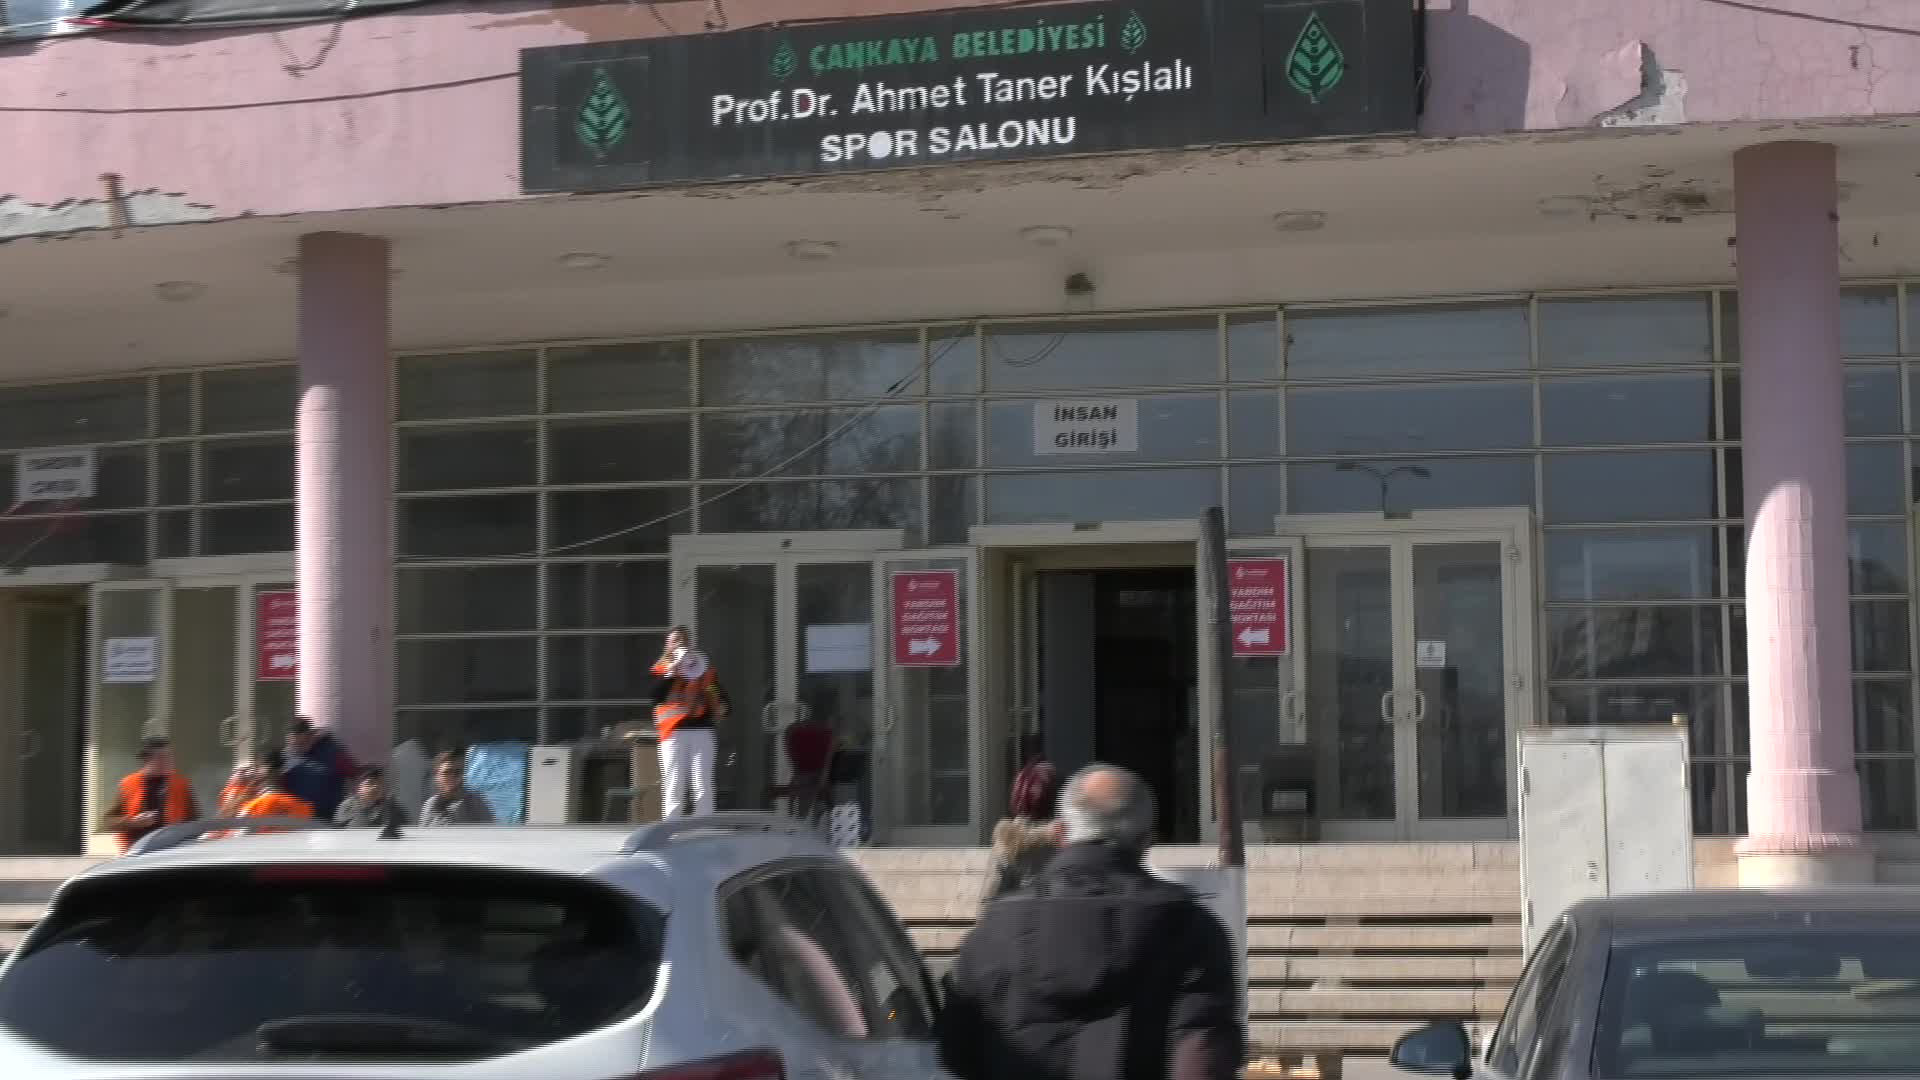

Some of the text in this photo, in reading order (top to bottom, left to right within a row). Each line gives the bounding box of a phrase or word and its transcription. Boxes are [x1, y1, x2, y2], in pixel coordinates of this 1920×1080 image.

[809, 15, 1105, 77] ÇANKAYA BELEDİYESİ
[711, 58, 1193, 127] Prof.Dr. Ahmet Taner Kışlalı
[820, 116, 1076, 162] SPOR SALONU
[1054, 404, 1118, 422] İNSAN
[1054, 427, 1117, 449] GİRİŞİ
[1231, 587, 1275, 598] YARDIM
[902, 599, 946, 609] YARDIM
